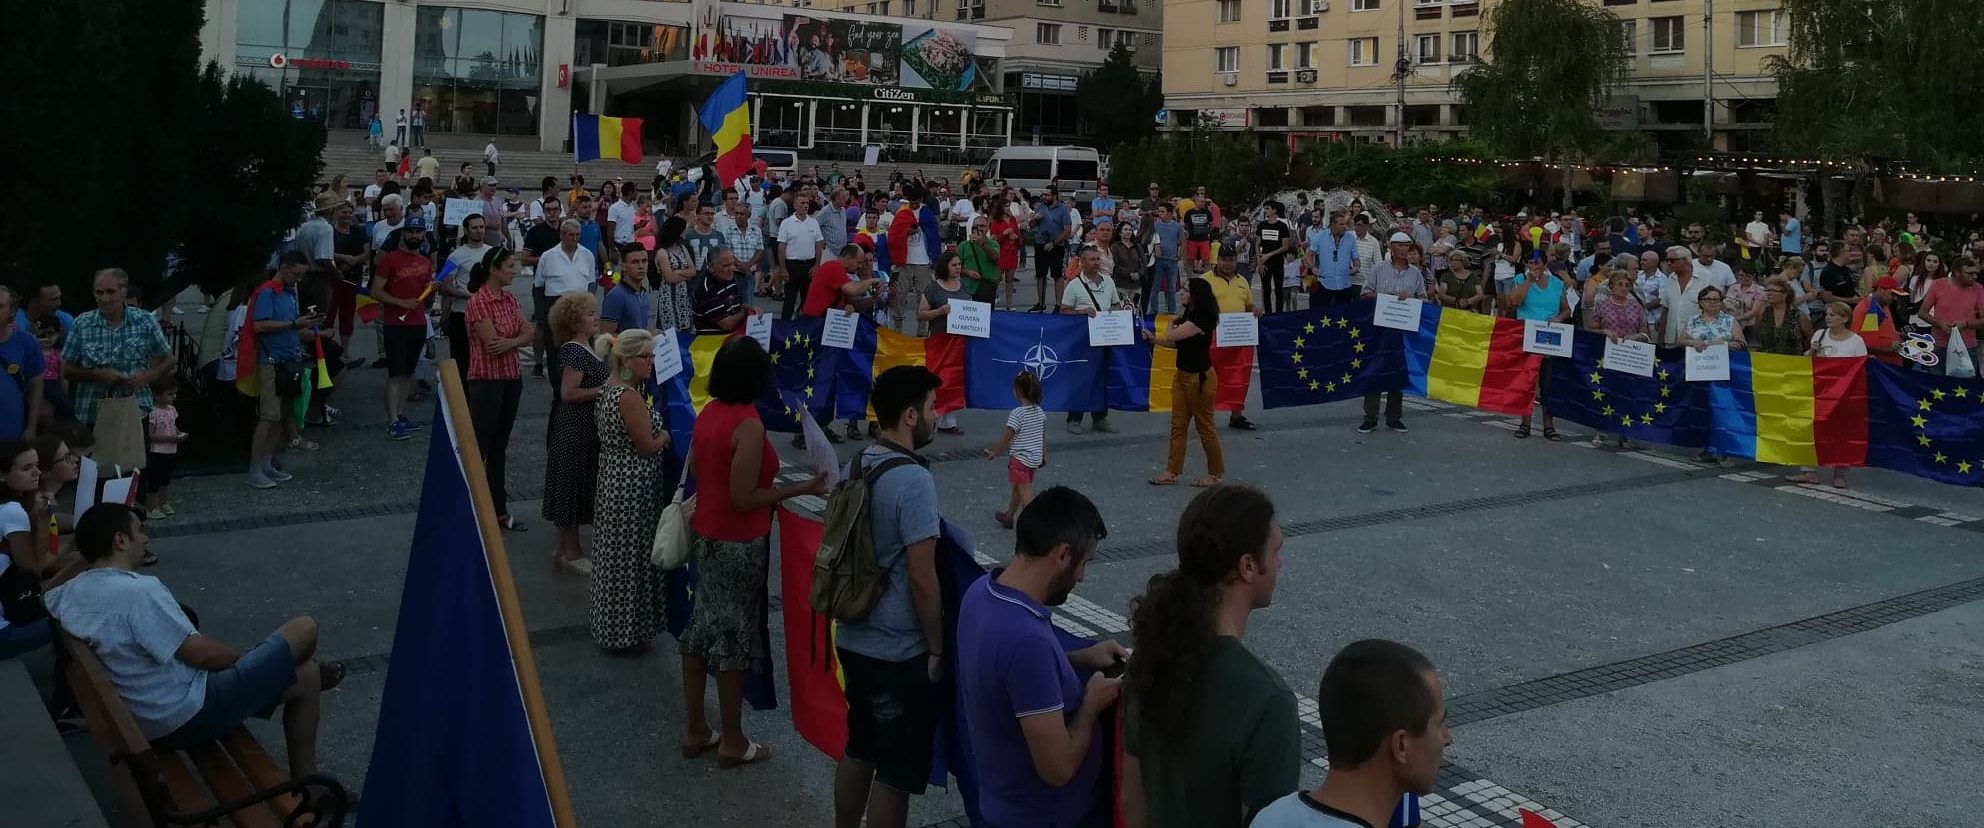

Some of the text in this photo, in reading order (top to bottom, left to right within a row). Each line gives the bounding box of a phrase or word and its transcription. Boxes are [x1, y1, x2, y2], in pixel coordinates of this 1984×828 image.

[704, 63, 797, 78] HOTEL UNIREA
[873, 87, 915, 100] CitiZen
